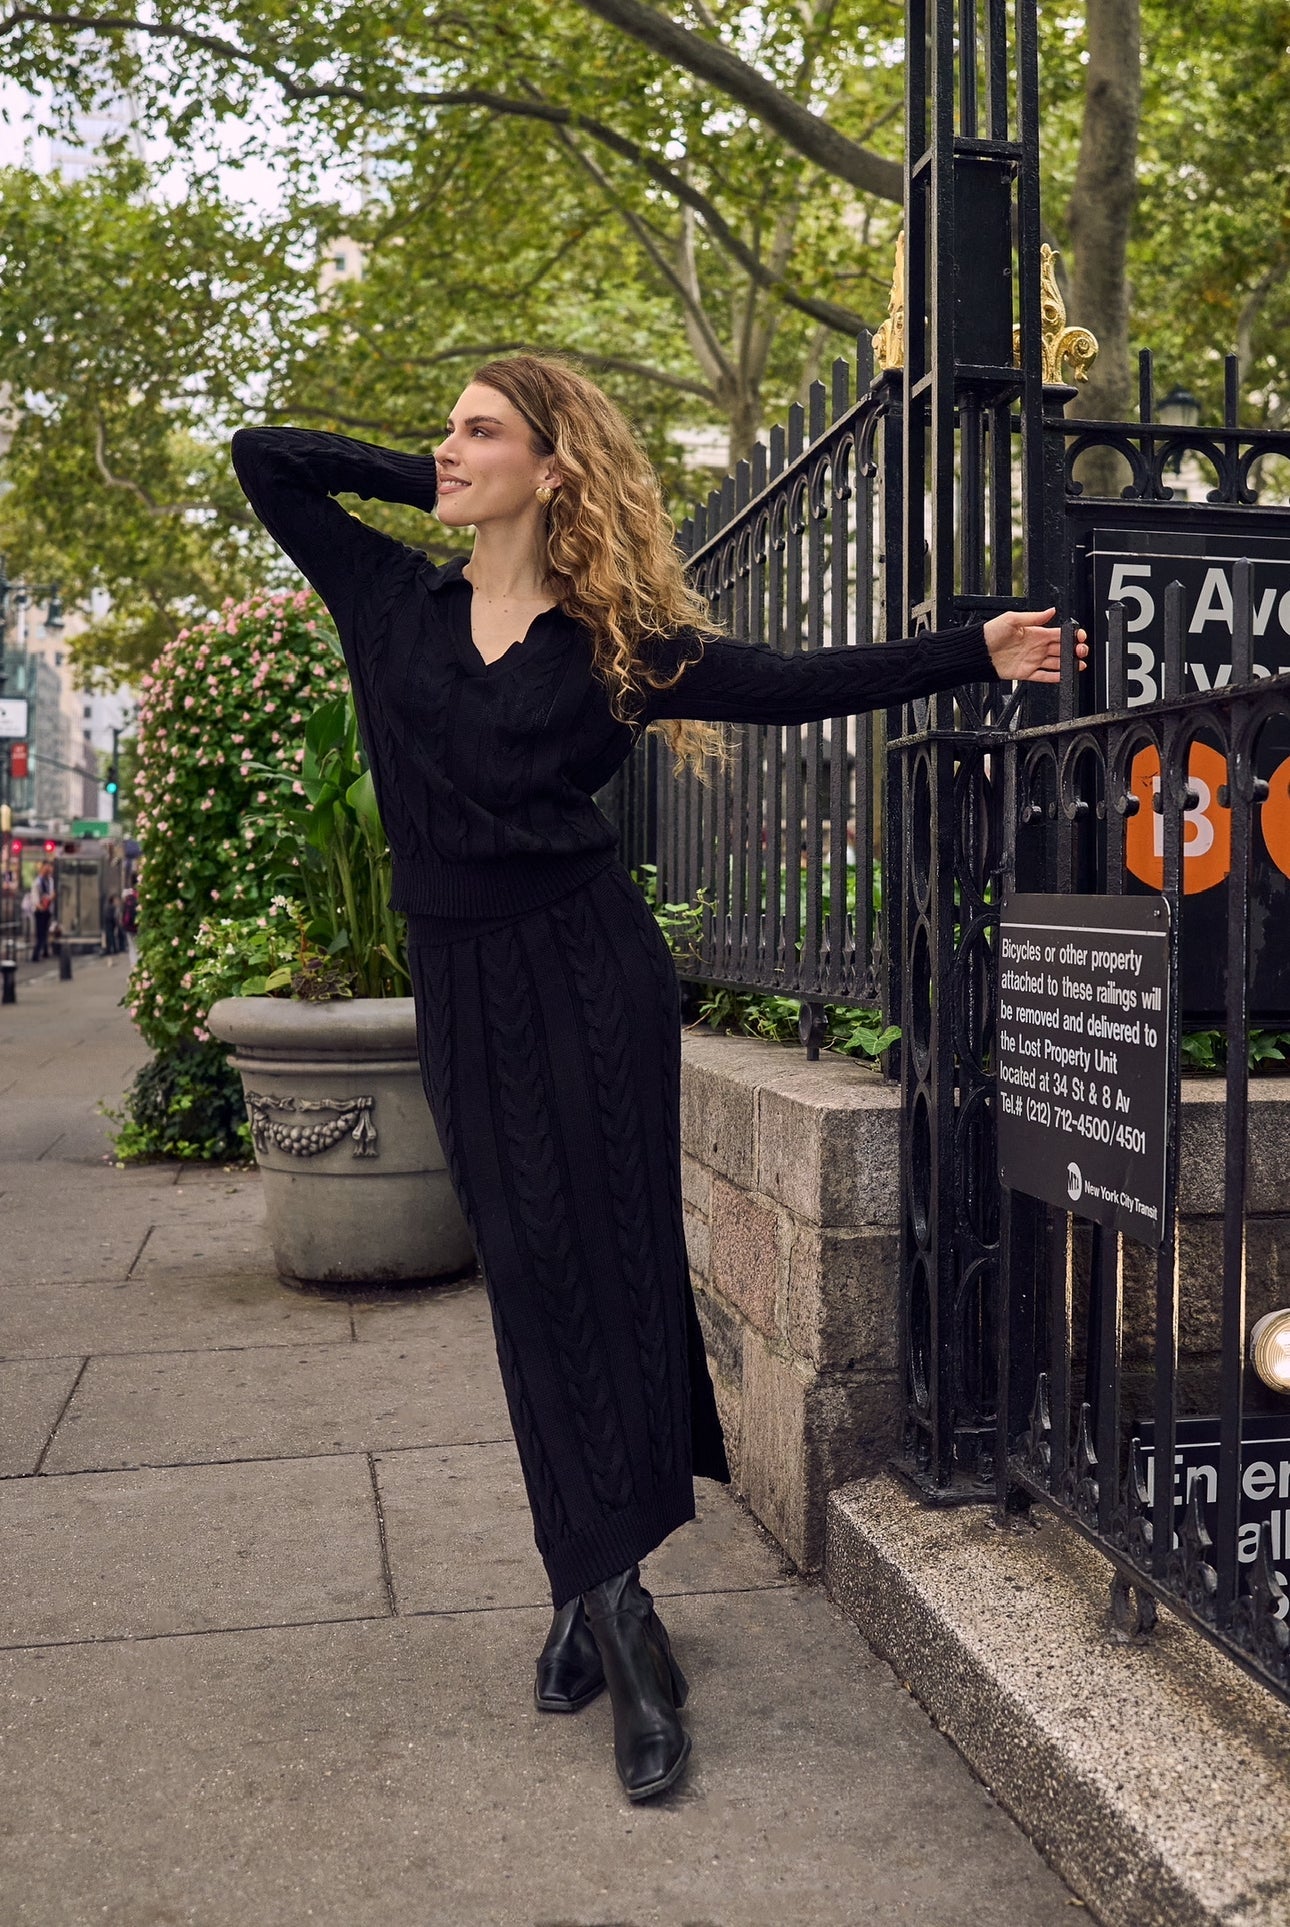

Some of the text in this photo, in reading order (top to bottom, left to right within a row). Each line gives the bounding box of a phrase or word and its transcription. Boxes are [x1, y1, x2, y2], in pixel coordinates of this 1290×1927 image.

[1105, 563, 1155, 633] 5
[1152, 776, 1215, 857] B
[1002, 938, 1143, 976] Bicycles or other property
[1001, 970, 1162, 1012] attached to these railings will
[1000, 1000, 1158, 1048] be removed and delivered to
[1000, 1030, 1118, 1075] the Lost Property Unit
[1000, 1060, 1131, 1114] located at 34 St & 8 Av
[1000, 1091, 1146, 1155] Tel.# (212) 712-4500/4501
[1084, 1180, 1158, 1221] New York City Transit
